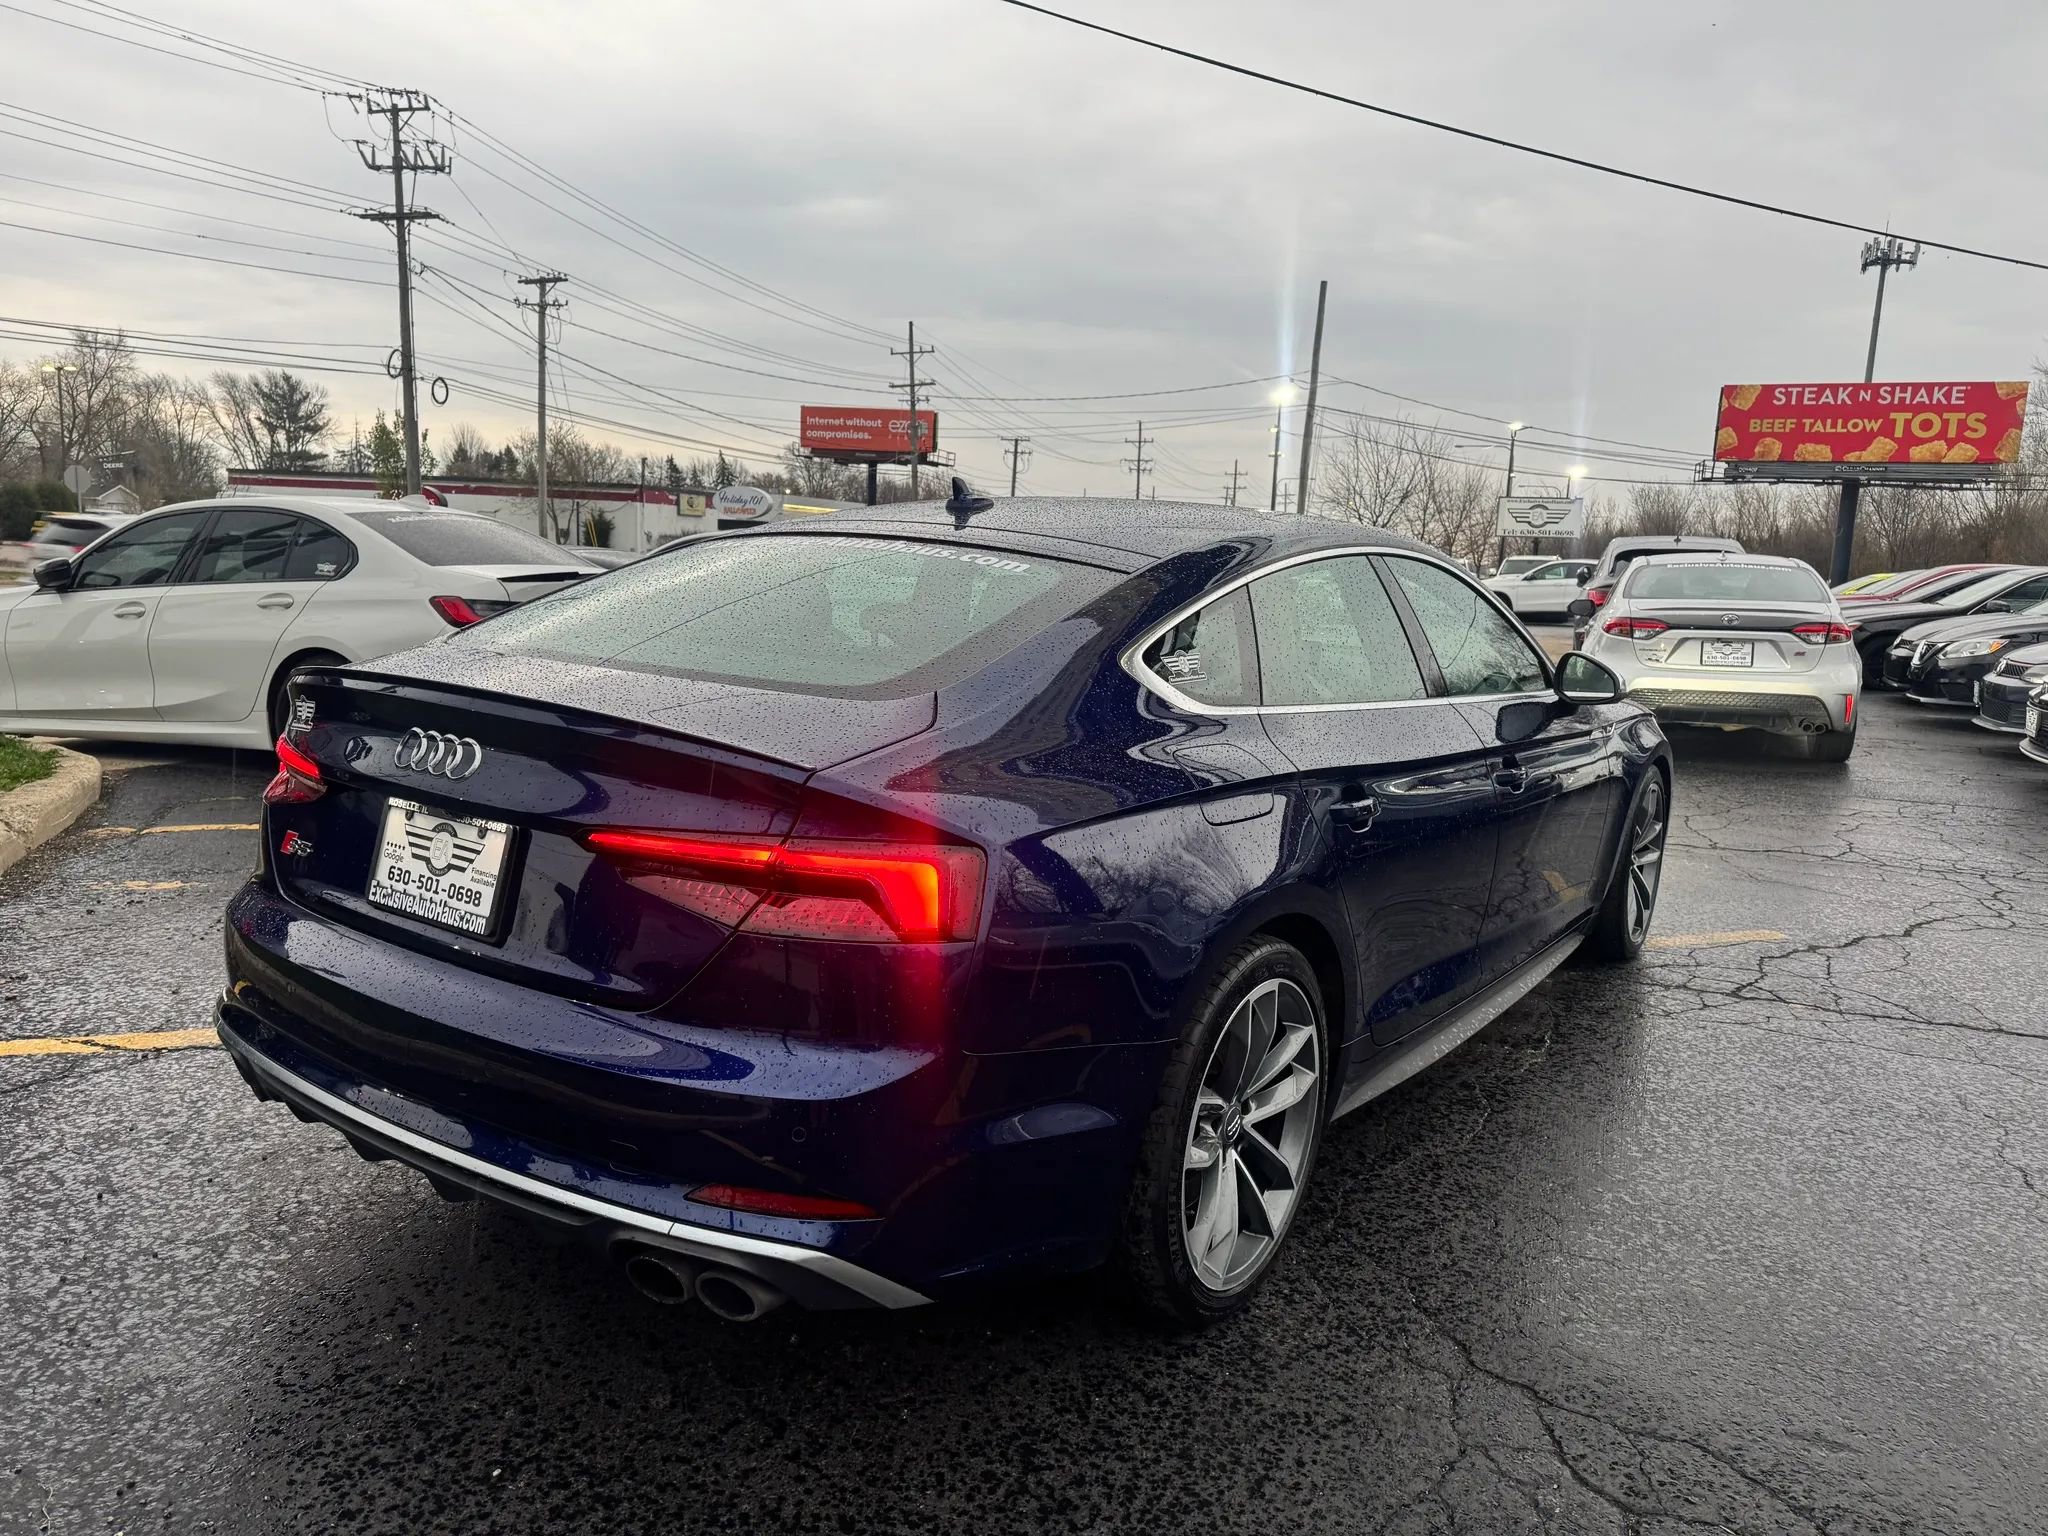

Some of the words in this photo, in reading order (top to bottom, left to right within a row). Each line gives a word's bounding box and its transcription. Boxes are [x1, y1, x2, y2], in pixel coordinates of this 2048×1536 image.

[1772, 386, 1852, 406] STEAK
[1858, 389, 1872, 403] N
[1876, 386, 1967, 405] SHAKE
[806, 416, 844, 426] Internet
[846, 417, 882, 428] without
[1749, 418, 1796, 433] BEEF
[1802, 418, 1883, 433] TALLOW
[1889, 412, 1988, 438] TOTS
[806, 429, 872, 440] compromises.
[719, 490, 748, 507] Holiday
[383, 848, 404, 864] Google
[470, 875, 495, 889] Available
[471, 867, 497, 881] Financing
[387, 865, 482, 907] 630-501-0698
[368, 879, 487, 935] ExclusiveAutoHaus.com
